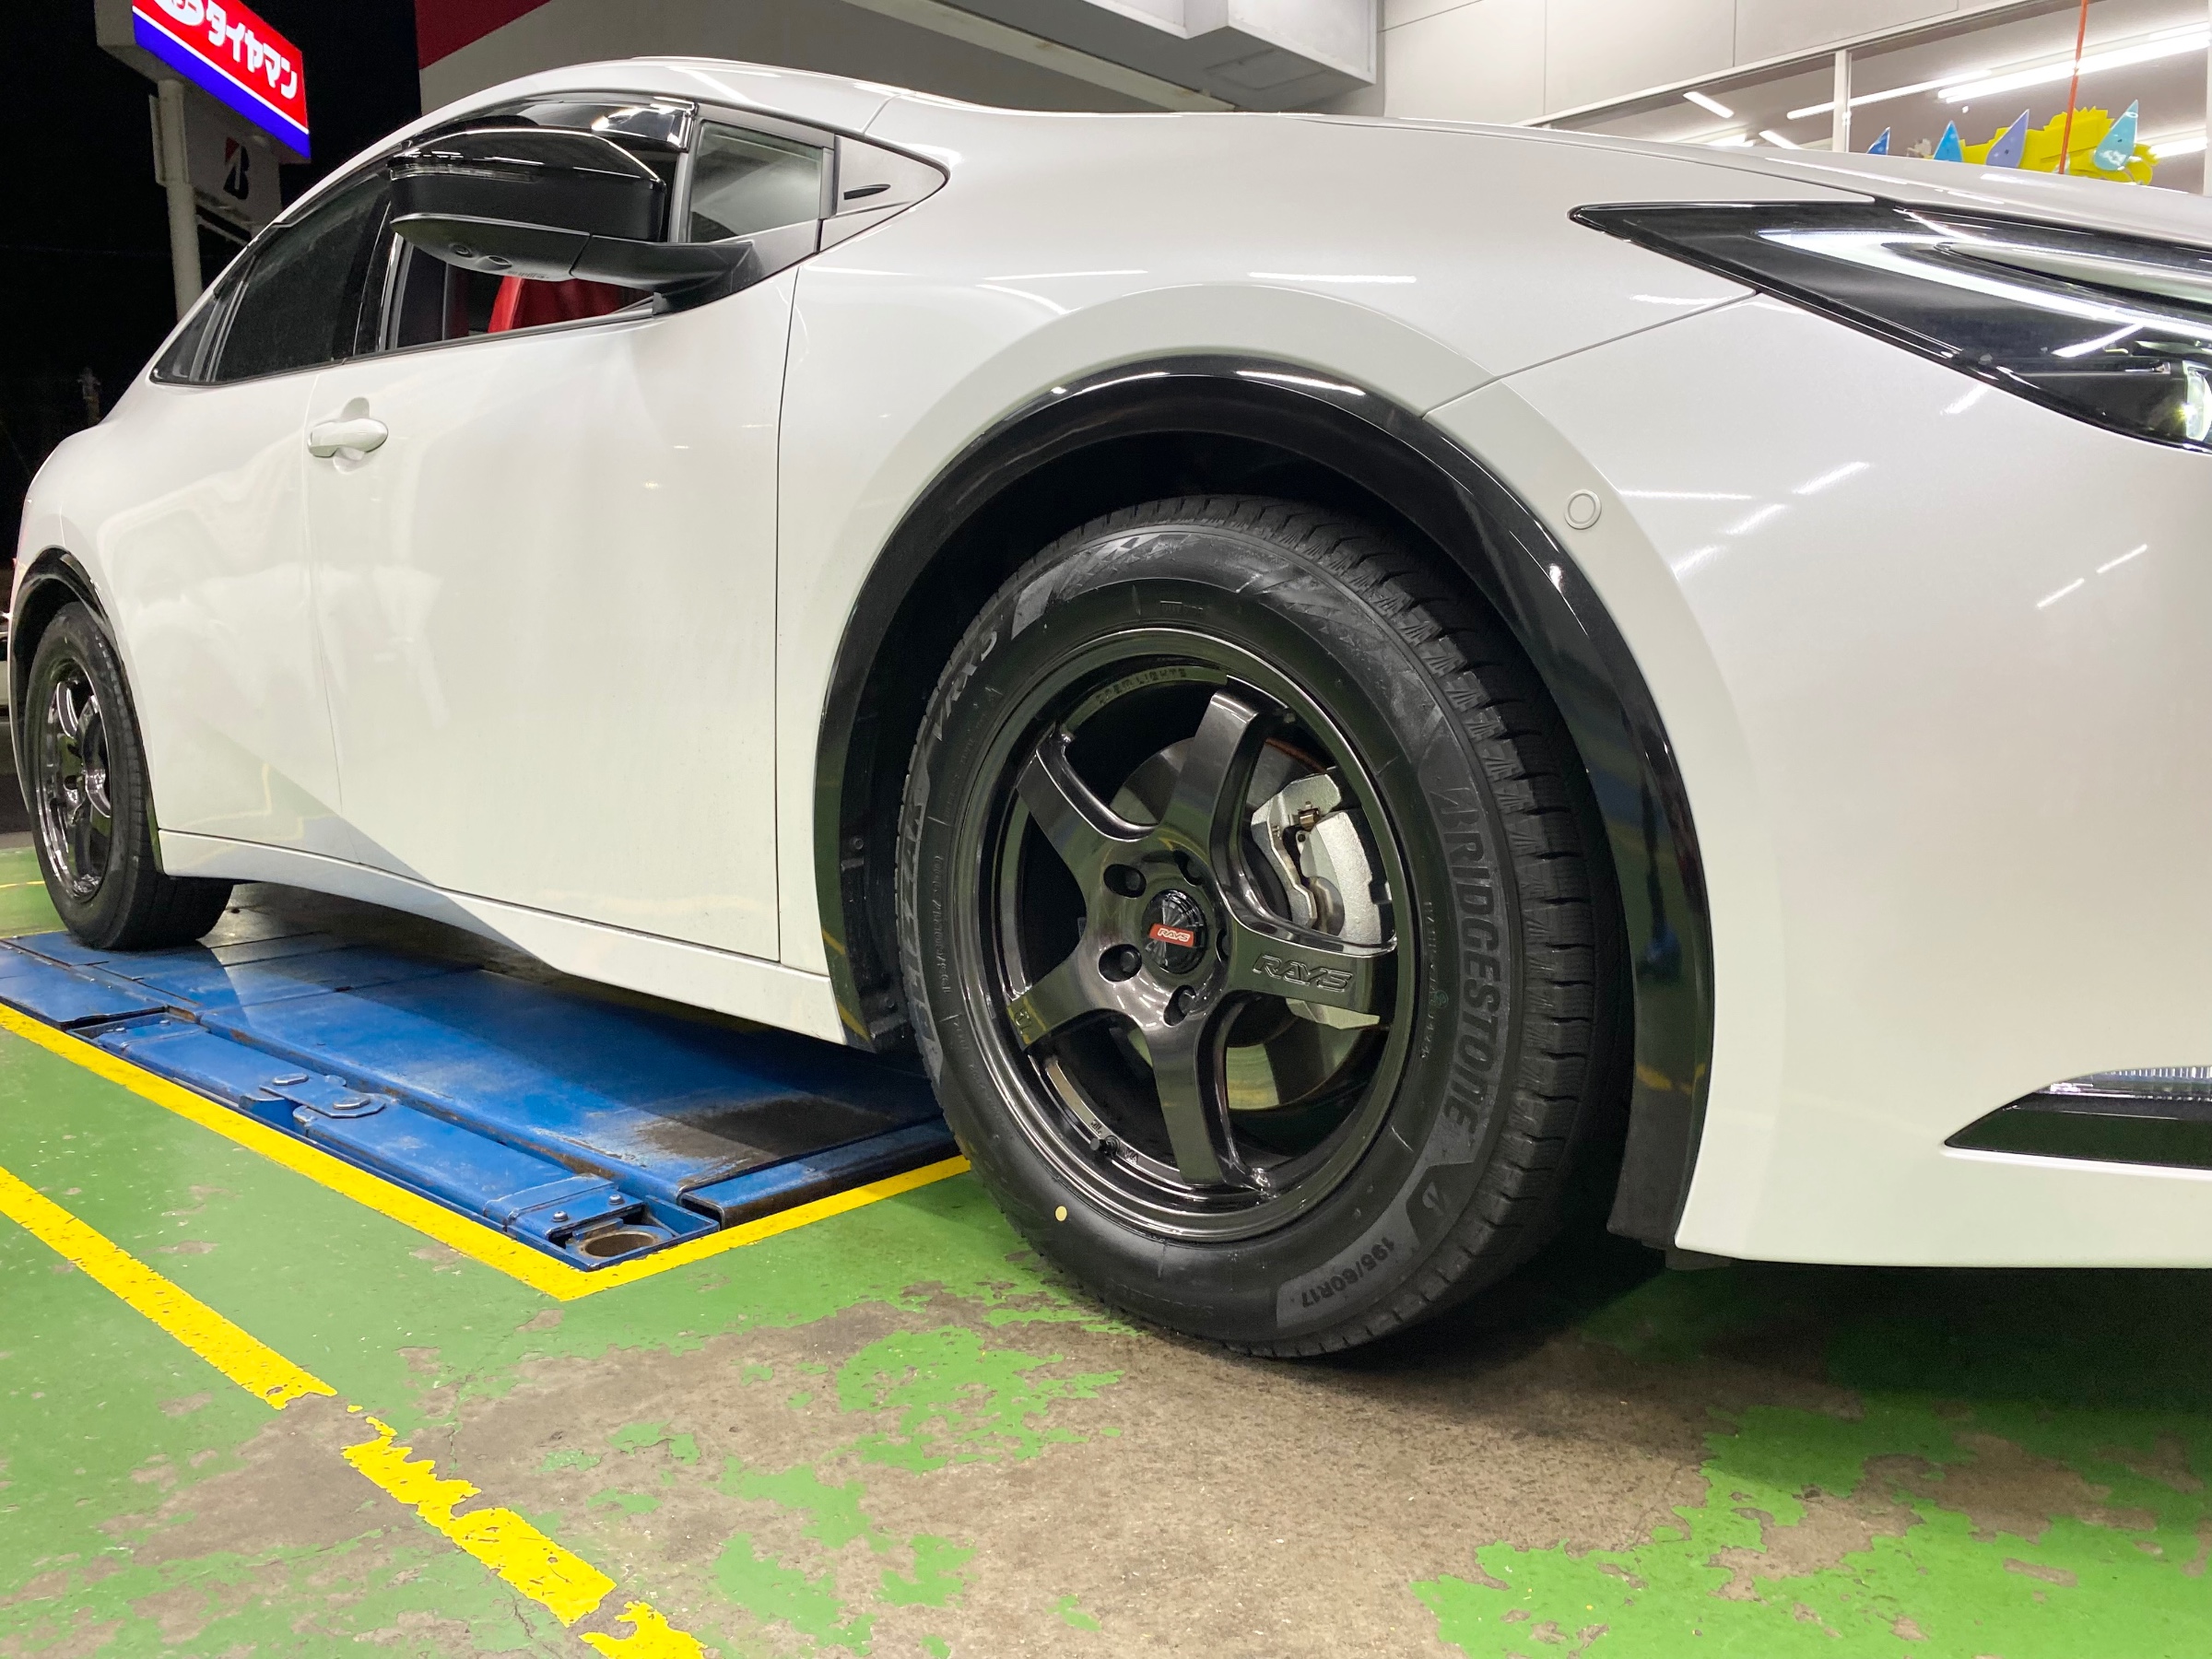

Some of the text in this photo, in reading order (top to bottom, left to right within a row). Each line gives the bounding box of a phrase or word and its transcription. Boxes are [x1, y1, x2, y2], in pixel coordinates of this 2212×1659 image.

[206, 0, 298, 100] タイヤマン
[1157, 927, 1191, 943] RAYS
[1430, 787, 1501, 1134] BRIDGESTONE
[1252, 953, 1353, 993] RAYS
[1300, 1236, 1394, 1308] 195/60R17
